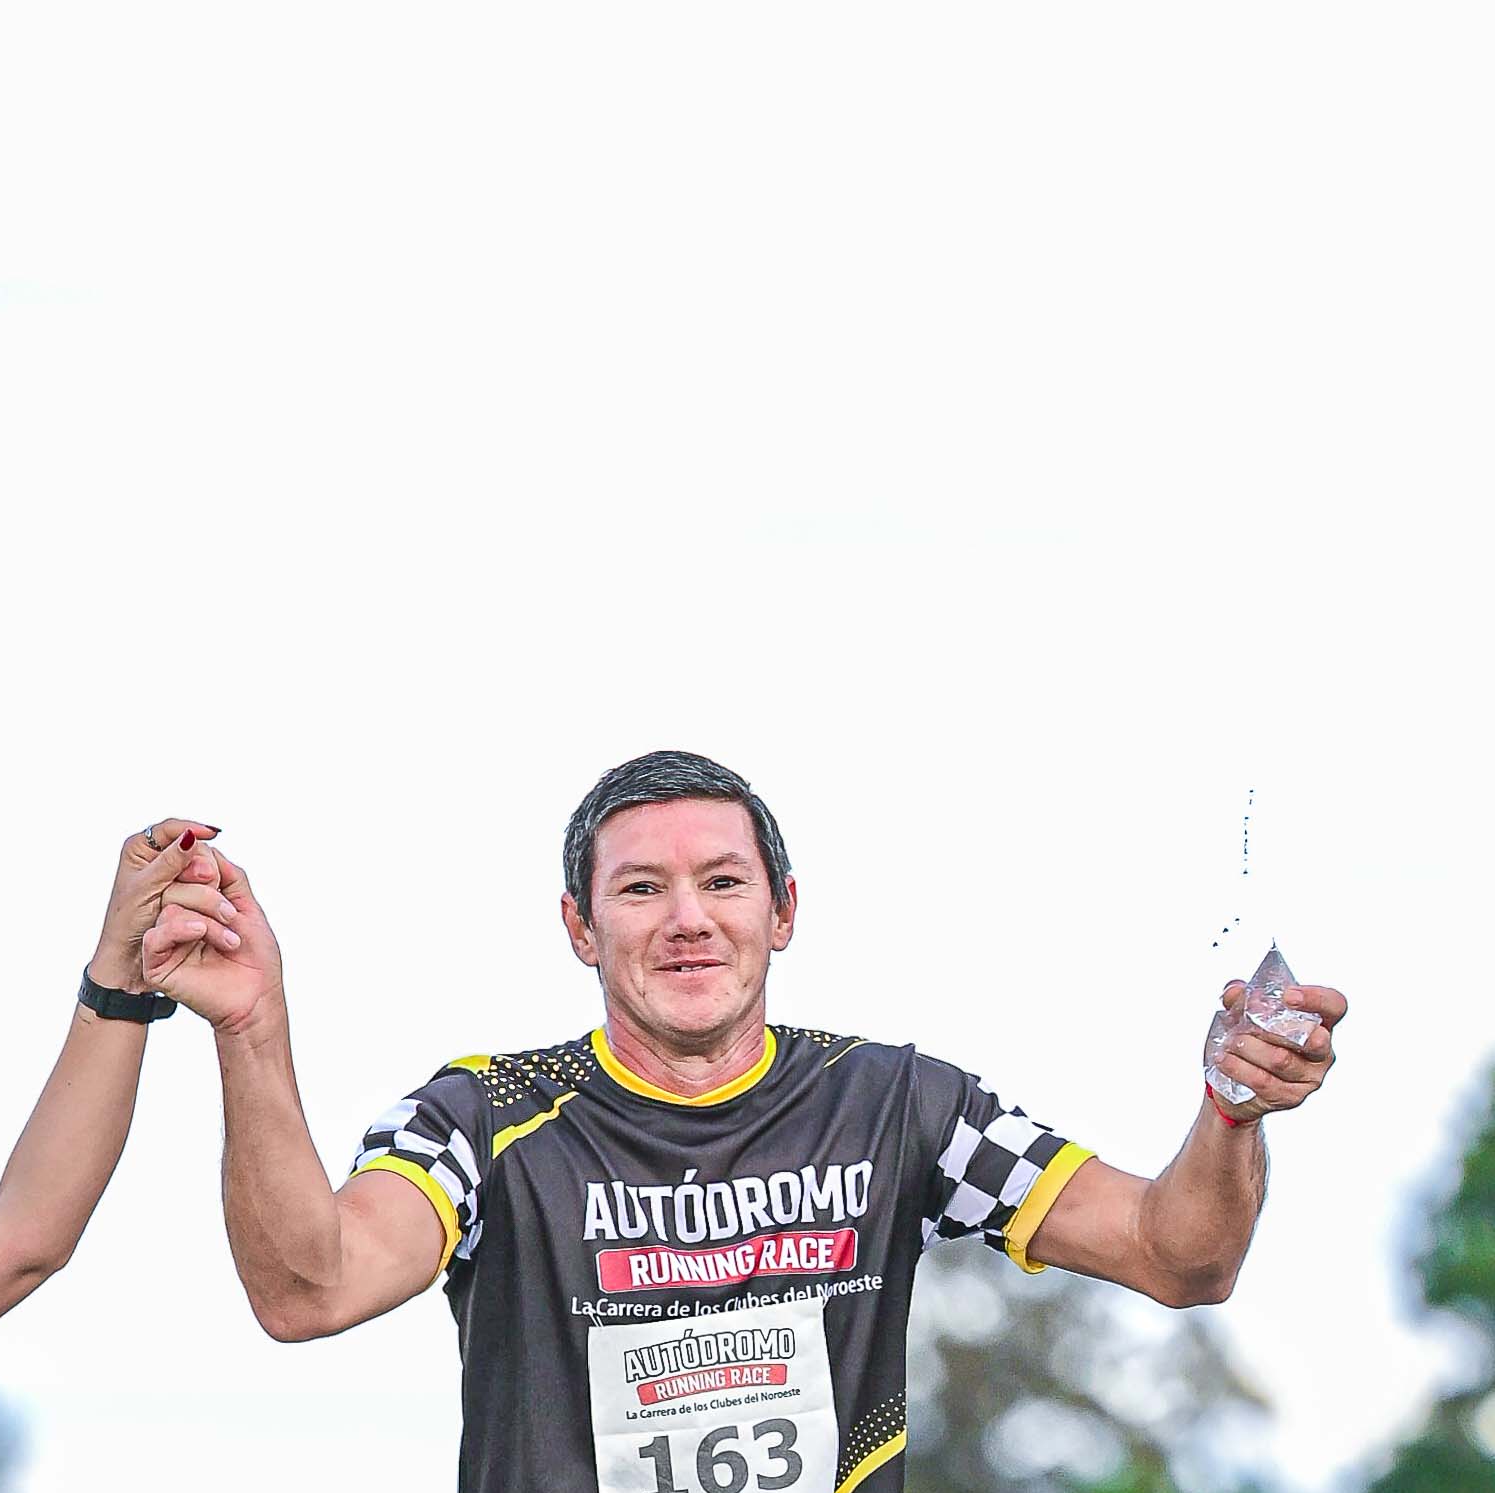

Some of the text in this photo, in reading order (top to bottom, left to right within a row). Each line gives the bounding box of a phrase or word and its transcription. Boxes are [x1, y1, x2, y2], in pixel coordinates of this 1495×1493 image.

[582, 1159, 874, 1244] AUTÓDROMO
[628, 1237, 835, 1287] RUNNING RACE
[571, 1273, 883, 1317] La Carrera de los Clubes del Noroeste
[624, 1328, 795, 1383] AUTÓDROMO
[626, 1388, 801, 1420] La Carrera de los Clubes del Noroeste
[654, 1367, 771, 1400] RUNNING RACE
